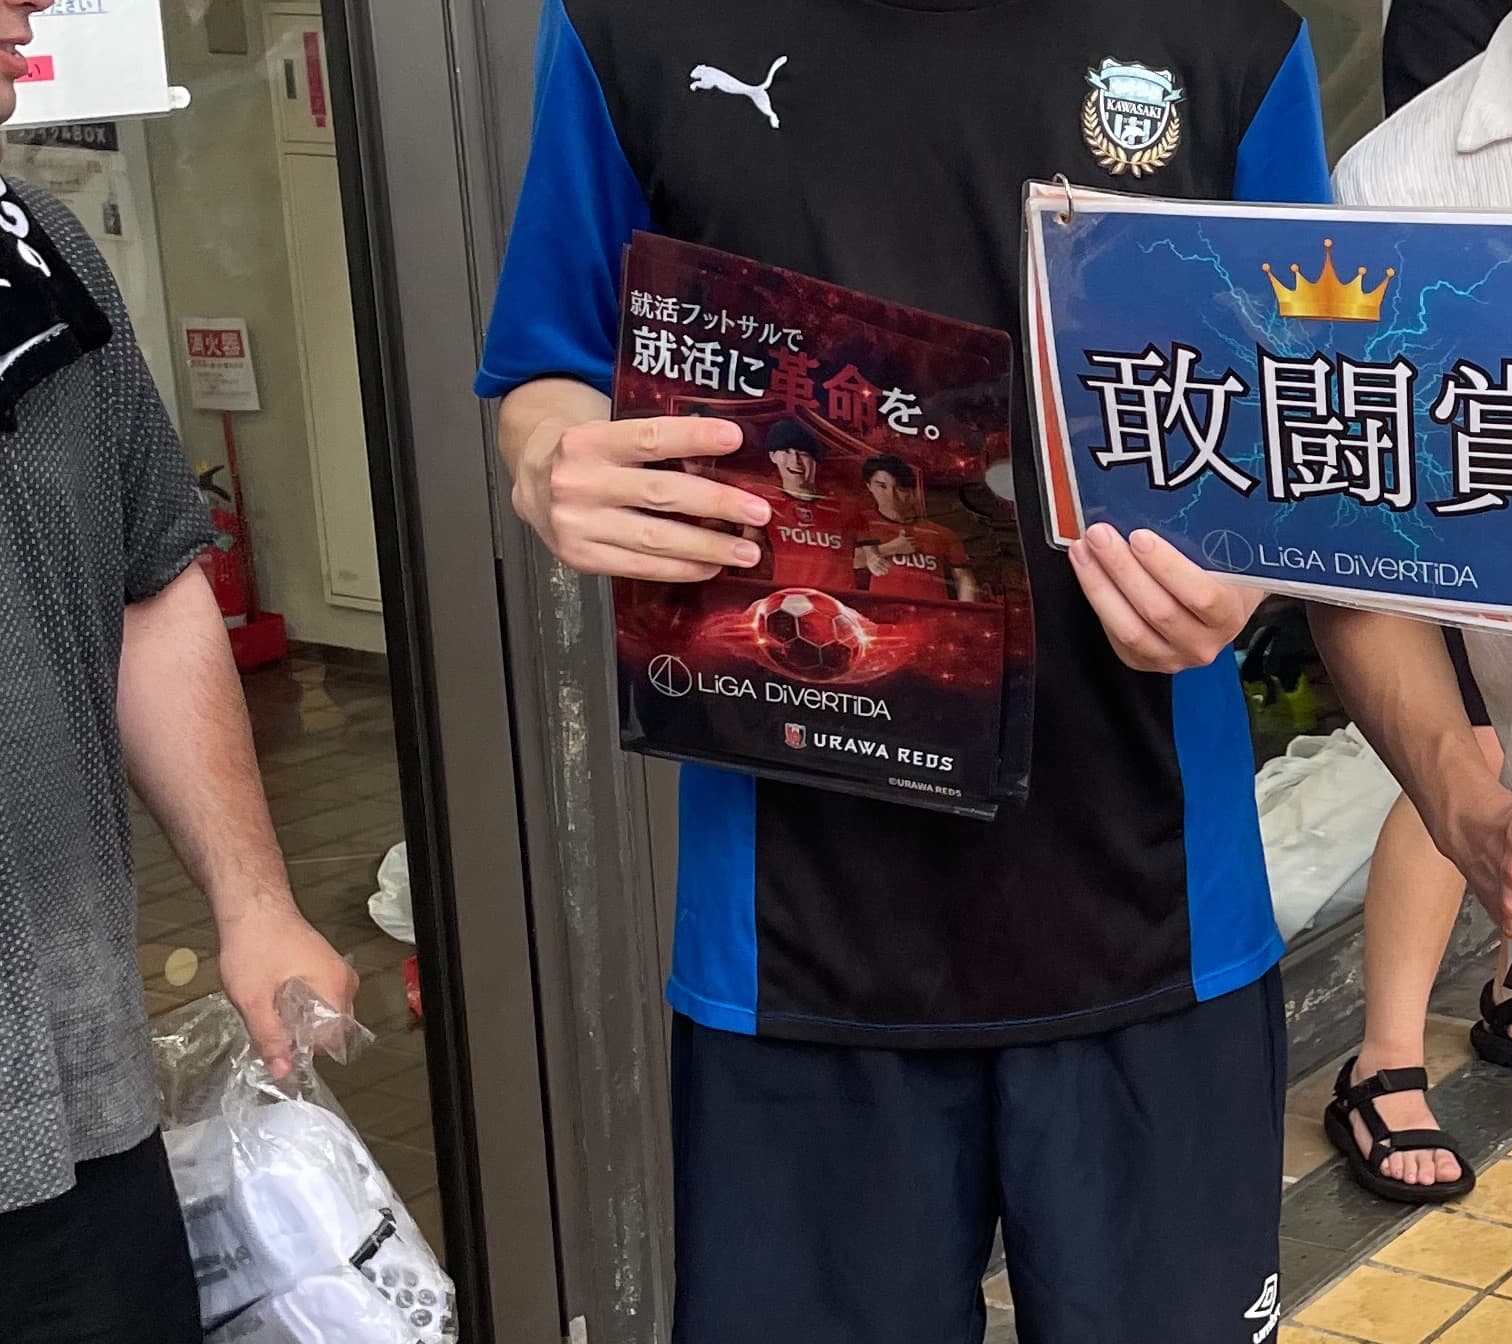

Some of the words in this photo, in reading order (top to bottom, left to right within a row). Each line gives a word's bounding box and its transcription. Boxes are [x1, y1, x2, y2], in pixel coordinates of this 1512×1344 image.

[1106, 98, 1162, 120] KAWASAKI
[630, 289, 804, 353] 就活フットサルで
[631, 325, 940, 441] 就活に革命を。
[777, 525, 842, 550] POLUS
[891, 553, 937, 571] OLUS
[813, 732, 889, 760] URAWA
[897, 747, 955, 772] REDS
[935, 787, 963, 798] REDS
